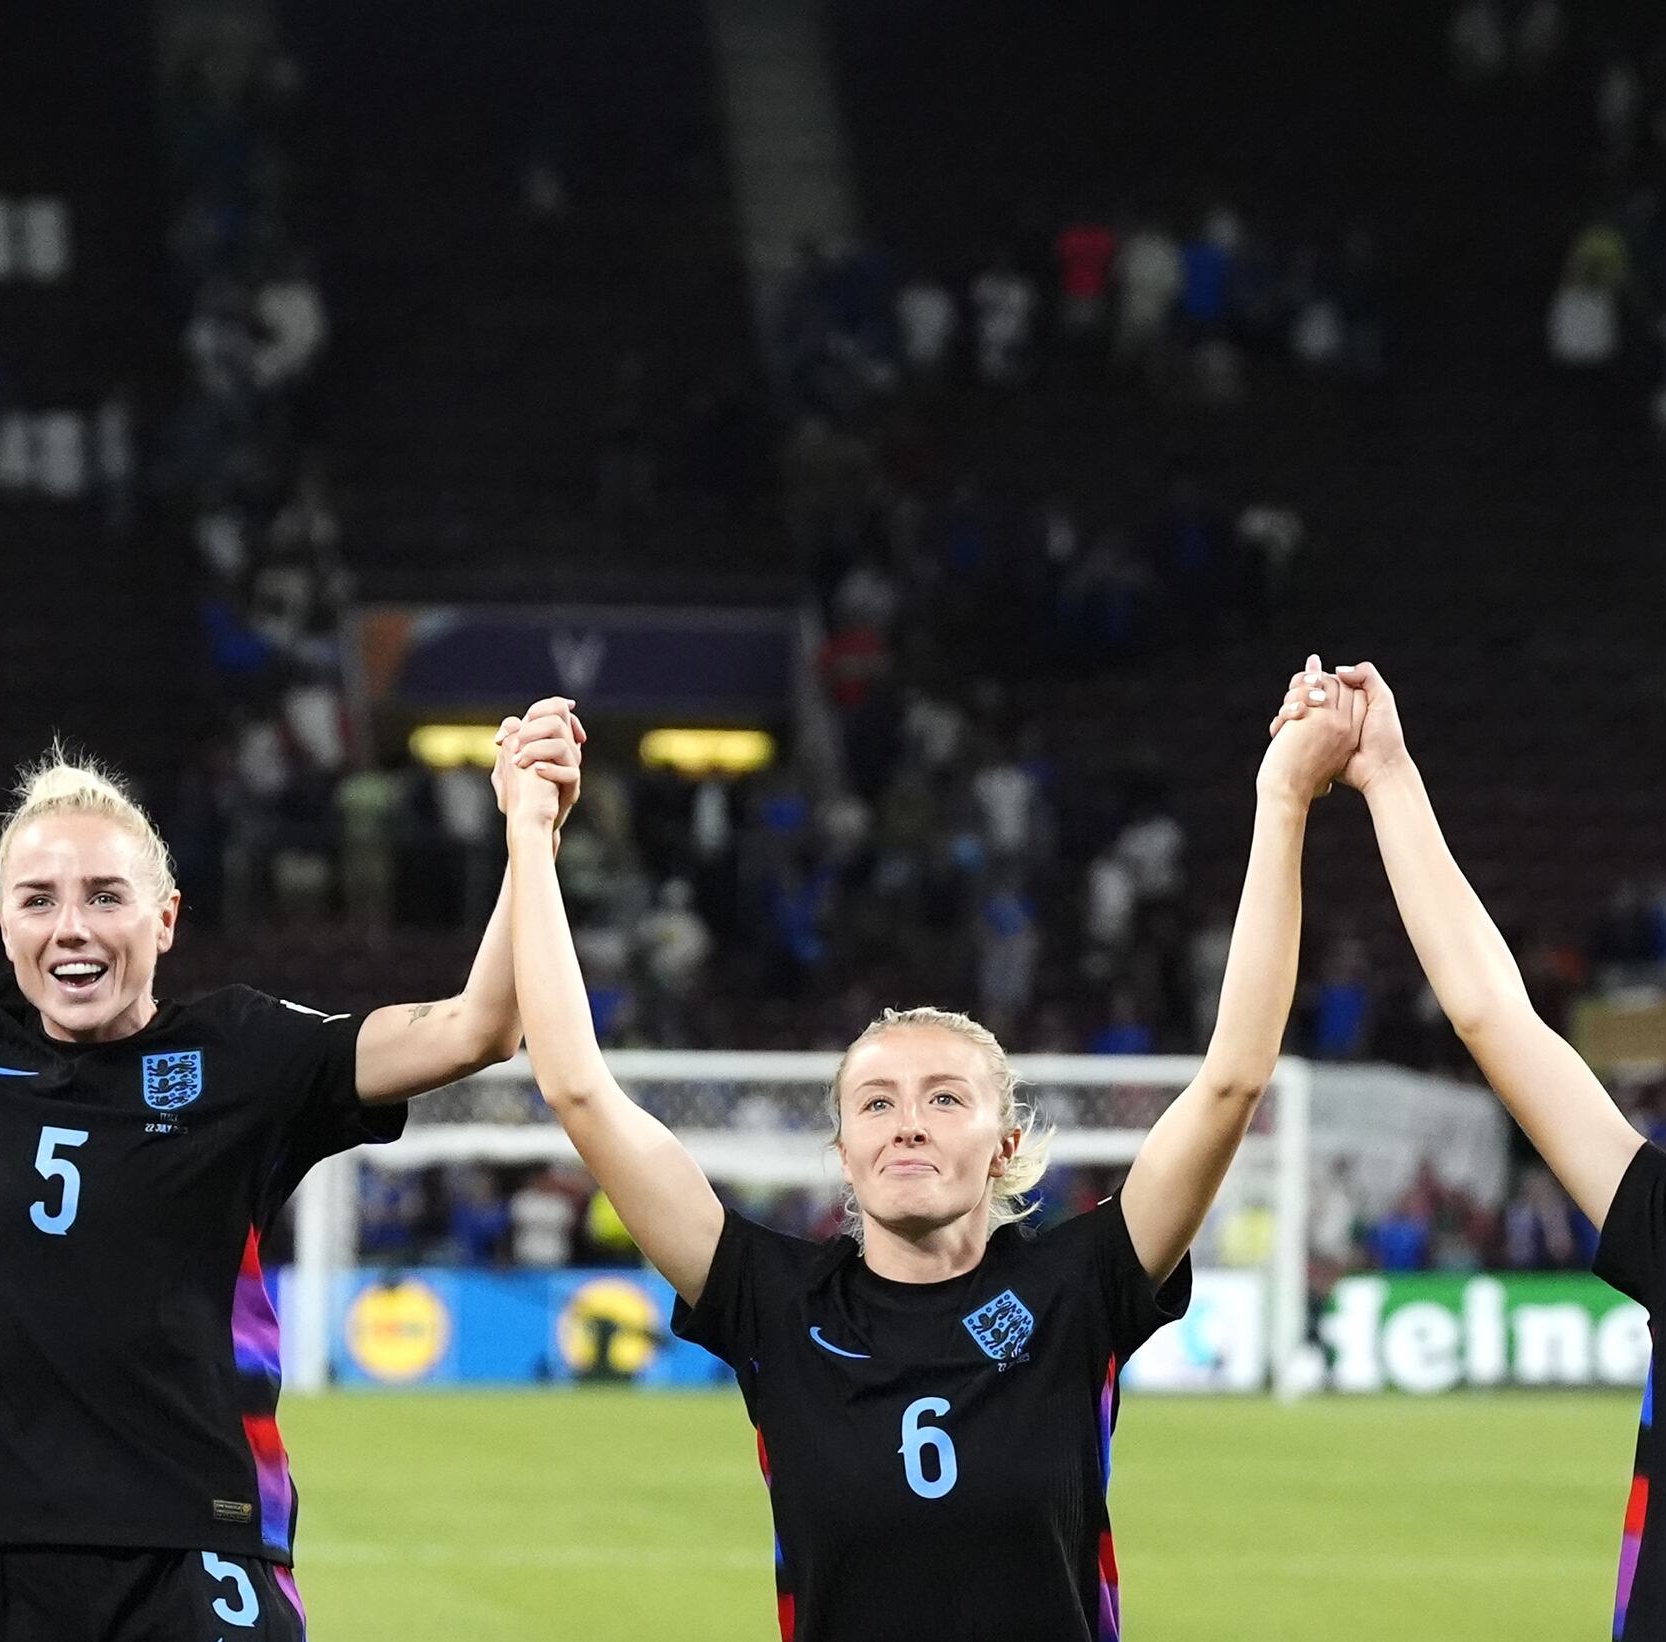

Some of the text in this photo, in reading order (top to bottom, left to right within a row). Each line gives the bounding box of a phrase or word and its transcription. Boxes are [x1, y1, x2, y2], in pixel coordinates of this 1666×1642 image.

[28, 1126, 89, 1236] 5
[898, 1396, 958, 1499] 6
[200, 1551, 261, 1628] 5
